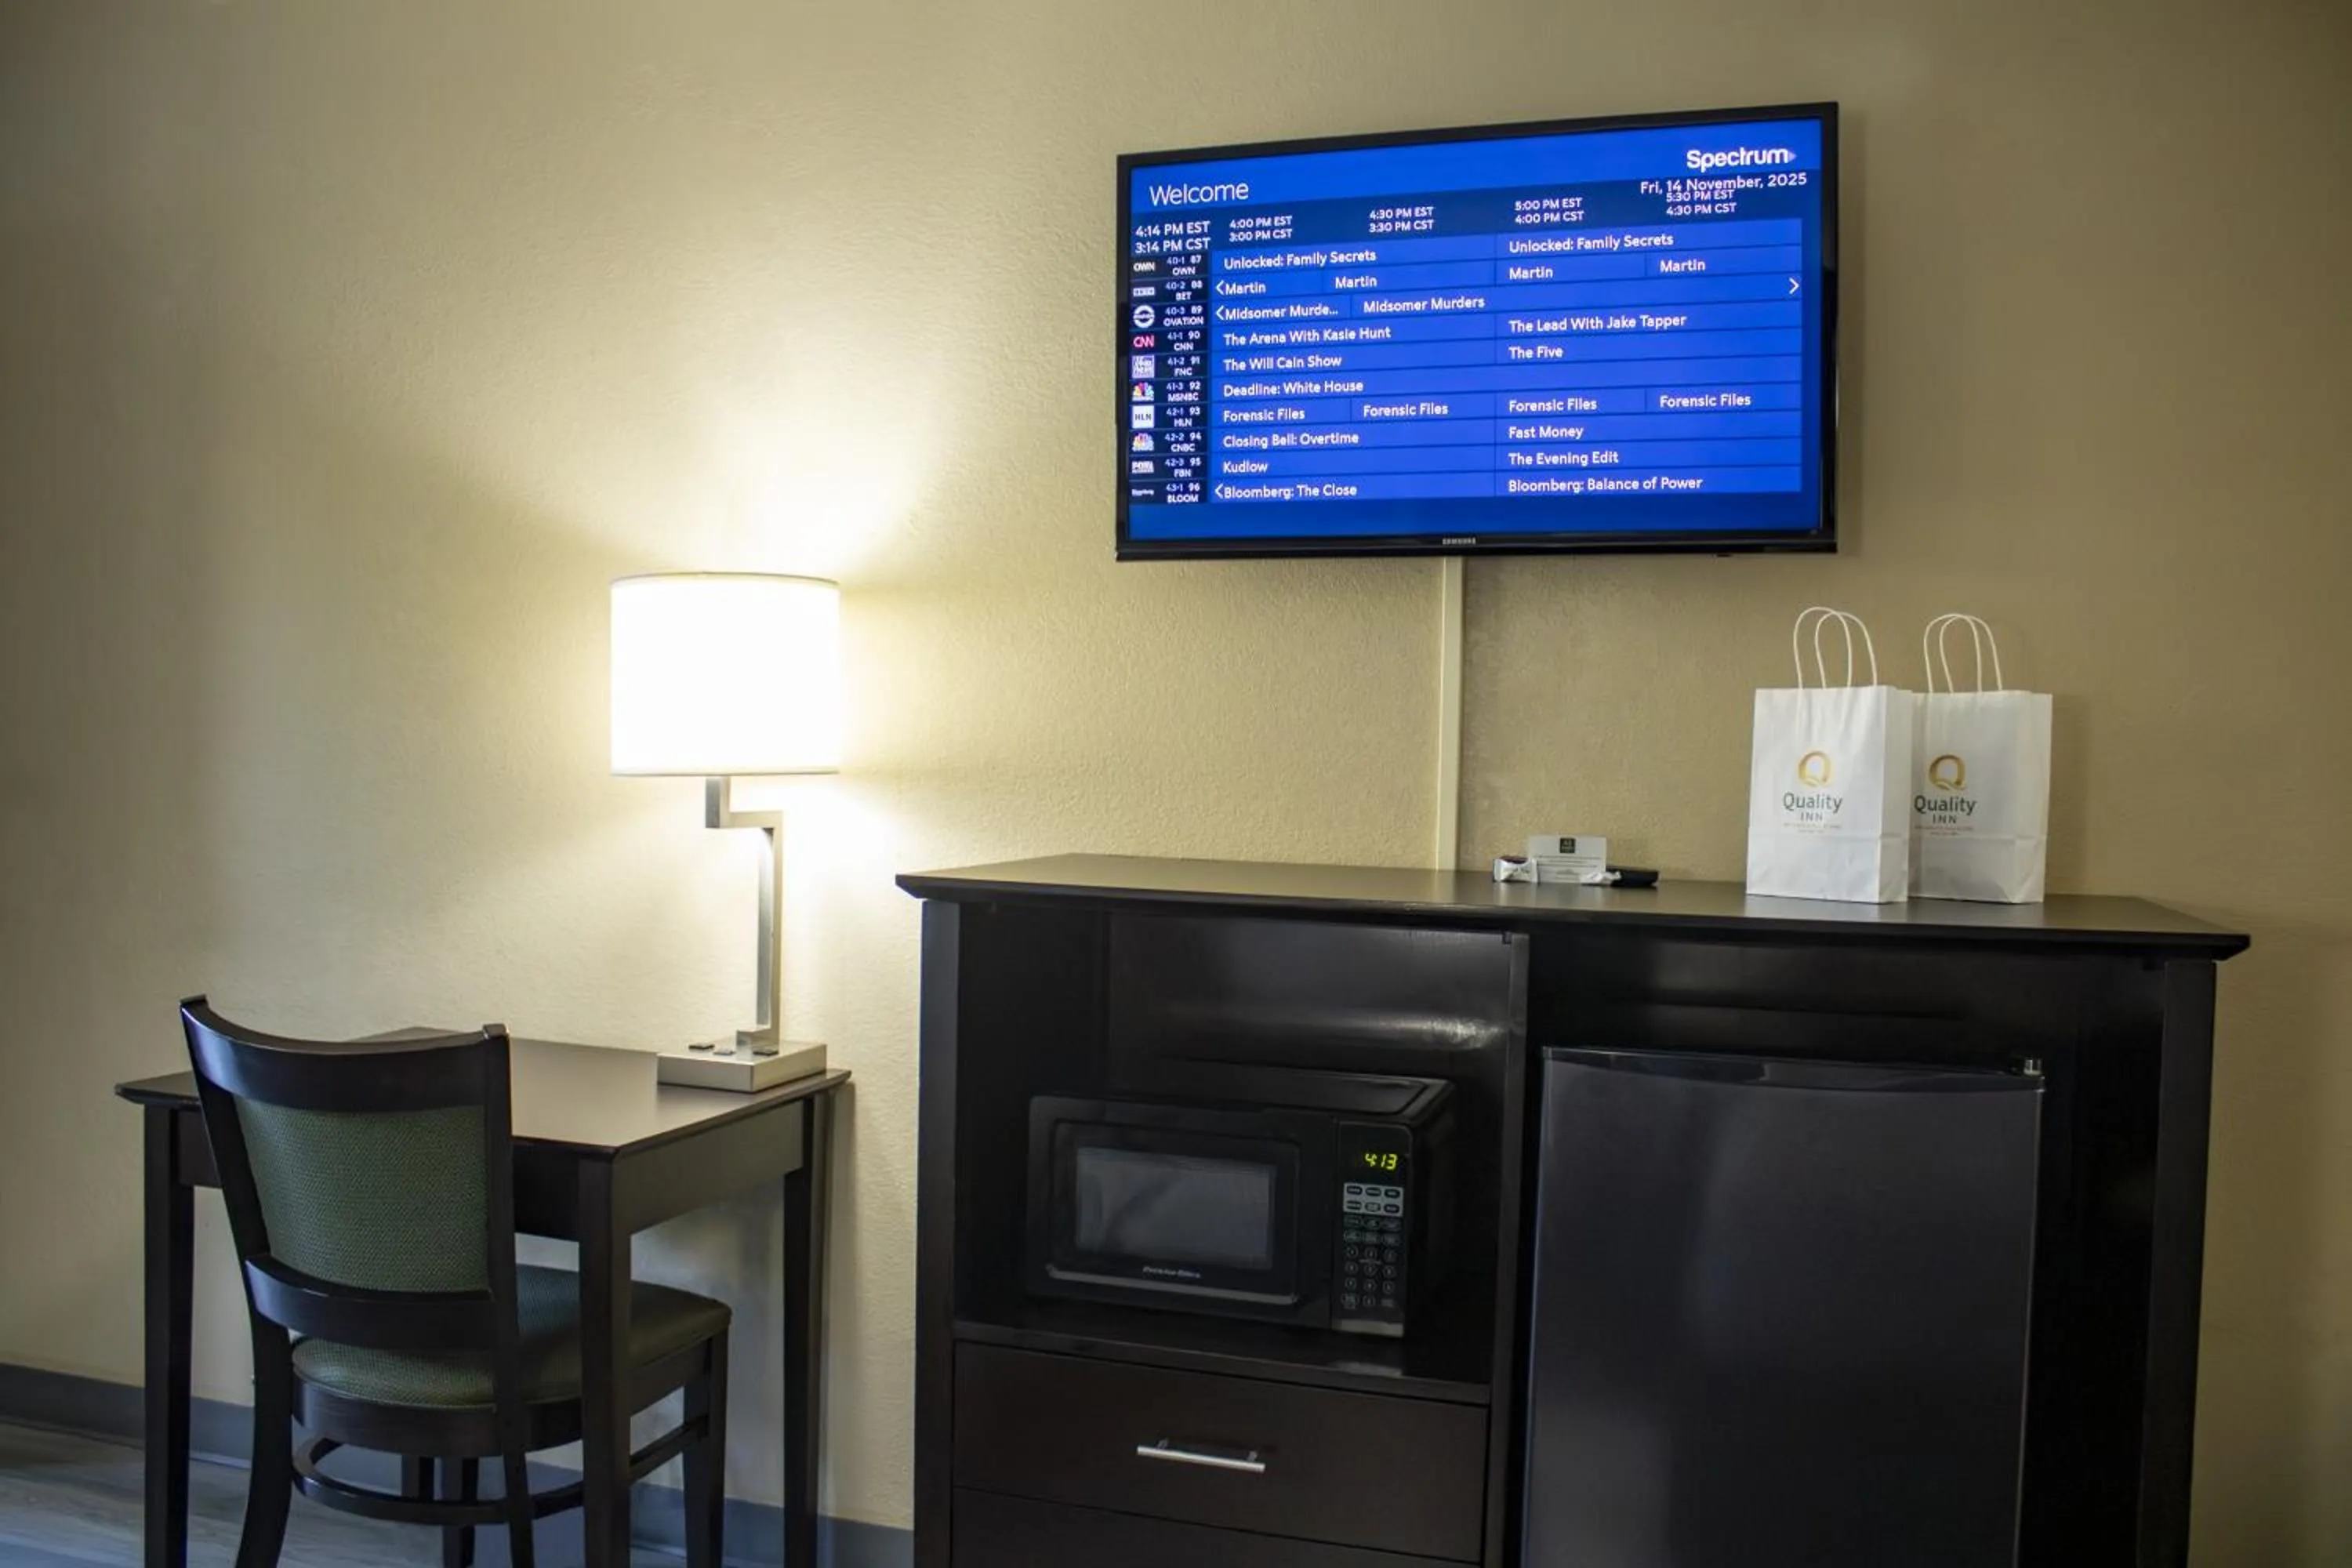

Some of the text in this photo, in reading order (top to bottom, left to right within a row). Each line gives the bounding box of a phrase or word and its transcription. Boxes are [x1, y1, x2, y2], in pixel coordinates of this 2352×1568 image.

[1686, 147, 1788, 172] Spectrum
[1640, 172, 1807, 194] Fri, 14 November, 2025
[1149, 183, 1249, 205] Welcome
[1666, 189, 1734, 203] 5:30 PM EST
[1515, 197, 1583, 211] 5:00 PM EST
[1666, 202, 1737, 216] 4:30 PM CST
[1370, 206, 1434, 220] 4:30 PM EST
[1515, 210, 1584, 223] 4:00 PM CST
[1135, 220, 1210, 237] 4:14 PM EST
[1229, 216, 1292, 229] 4:00 PM EST
[1370, 219, 1433, 232] 3:30 PM CST
[1229, 229, 1292, 241] 3:00 PM CST
[1135, 237, 1210, 253] 3:14 PM CST
[1509, 234, 1674, 253] Unlocked: Family Secrets
[1224, 250, 1376, 270] Unlocked: Family Secrets
[1661, 259, 1705, 272] Martin
[1509, 267, 1553, 279] Martin
[1225, 282, 1266, 295] Martin
[1335, 276, 1377, 289] Martin
[1364, 296, 1485, 313] Midsomer Murders
[1225, 307, 1287, 320] Midsomer
[1163, 317, 1204, 326] OVATION
[1508, 314, 1686, 332] The Lead With Jake Tapper
[1133, 335, 1155, 347] CNN
[1224, 327, 1391, 345] The Arena With Kasie Hunt
[1174, 343, 1193, 351] CNN
[1508, 346, 1563, 358] The Five
[1223, 354, 1341, 371] The Will Cain Show
[1224, 380, 1363, 397] Deadline: White House
[1509, 398, 1597, 412] Forensic Files
[1660, 394, 1751, 408] Forensic Files
[1224, 408, 1305, 422] Forensic Files
[1363, 402, 1448, 417] Forensic Files
[1509, 426, 1584, 439] Fast Money
[1223, 433, 1359, 449] Closing Bell: Overtime
[1508, 451, 1618, 466] The Evening Edit
[1223, 460, 1268, 473] Kudlow
[1224, 484, 1357, 499] Bloomberg: The Close
[1508, 477, 1703, 493] Bloomberg: Balance of Power
[1167, 495, 1199, 503] BLOOM
[1784, 791, 1842, 814] Quality
[1914, 795, 1976, 815] Quality
[1801, 812, 1823, 821] INN
[1933, 814, 1956, 823] INN
